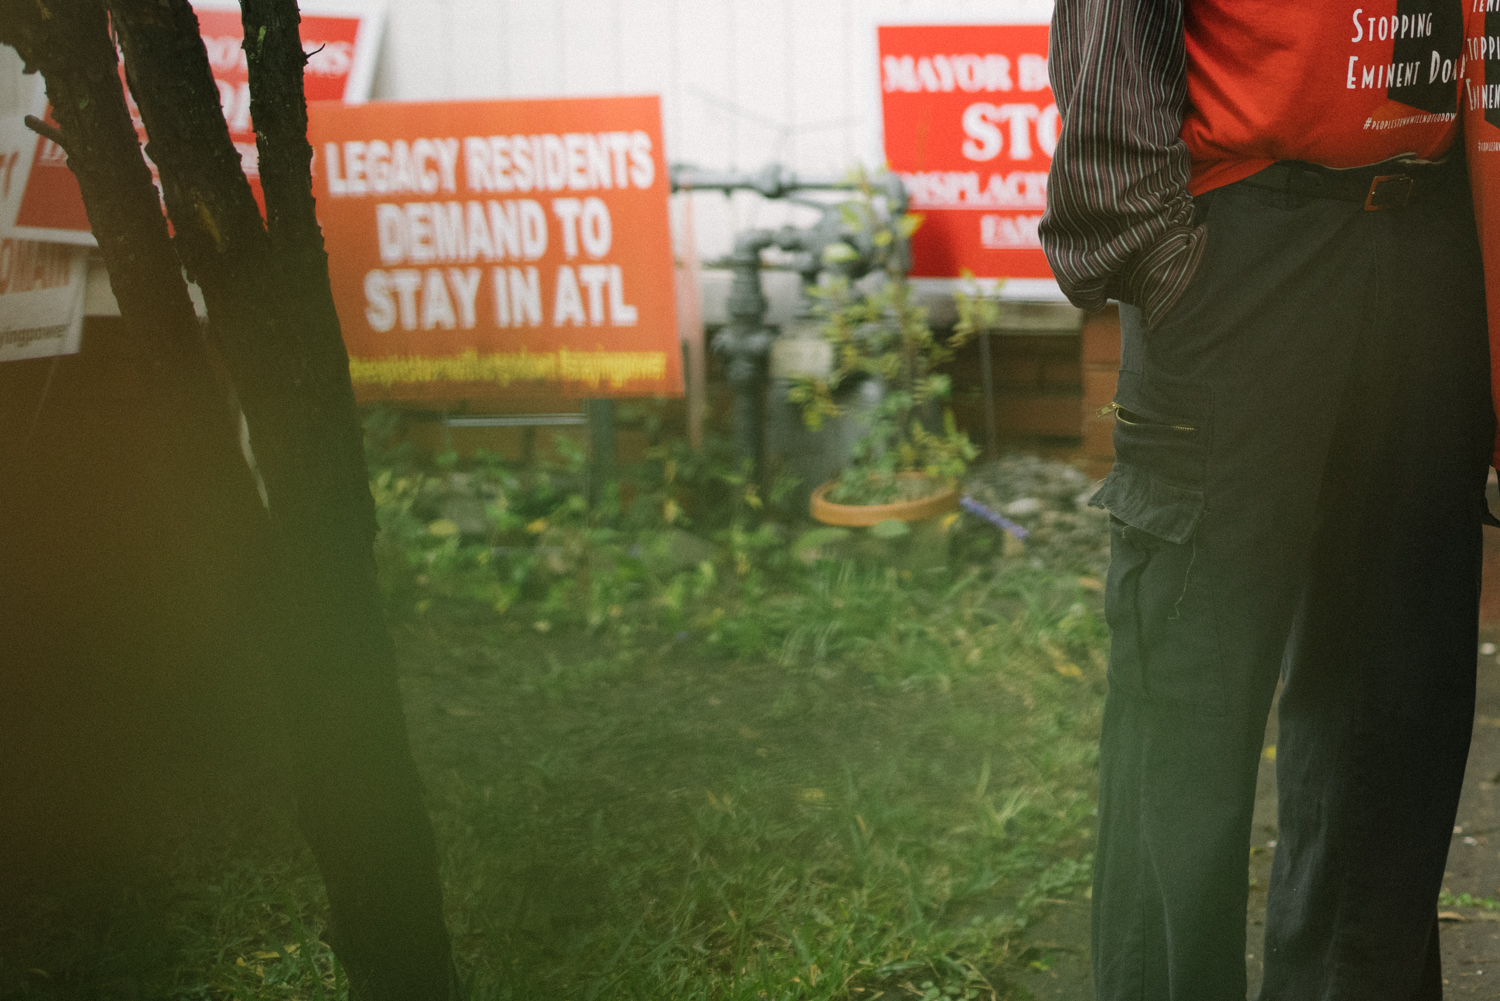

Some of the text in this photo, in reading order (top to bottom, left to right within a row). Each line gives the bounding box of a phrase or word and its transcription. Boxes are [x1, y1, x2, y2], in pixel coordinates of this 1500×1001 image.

[882, 53, 1013, 93] MAYOR
[324, 130, 656, 198] LEGACY RESIDENTS
[961, 102, 1061, 162] STO
[375, 197, 613, 266] DEMAND TO
[363, 264, 639, 332] STAY IN ATL
